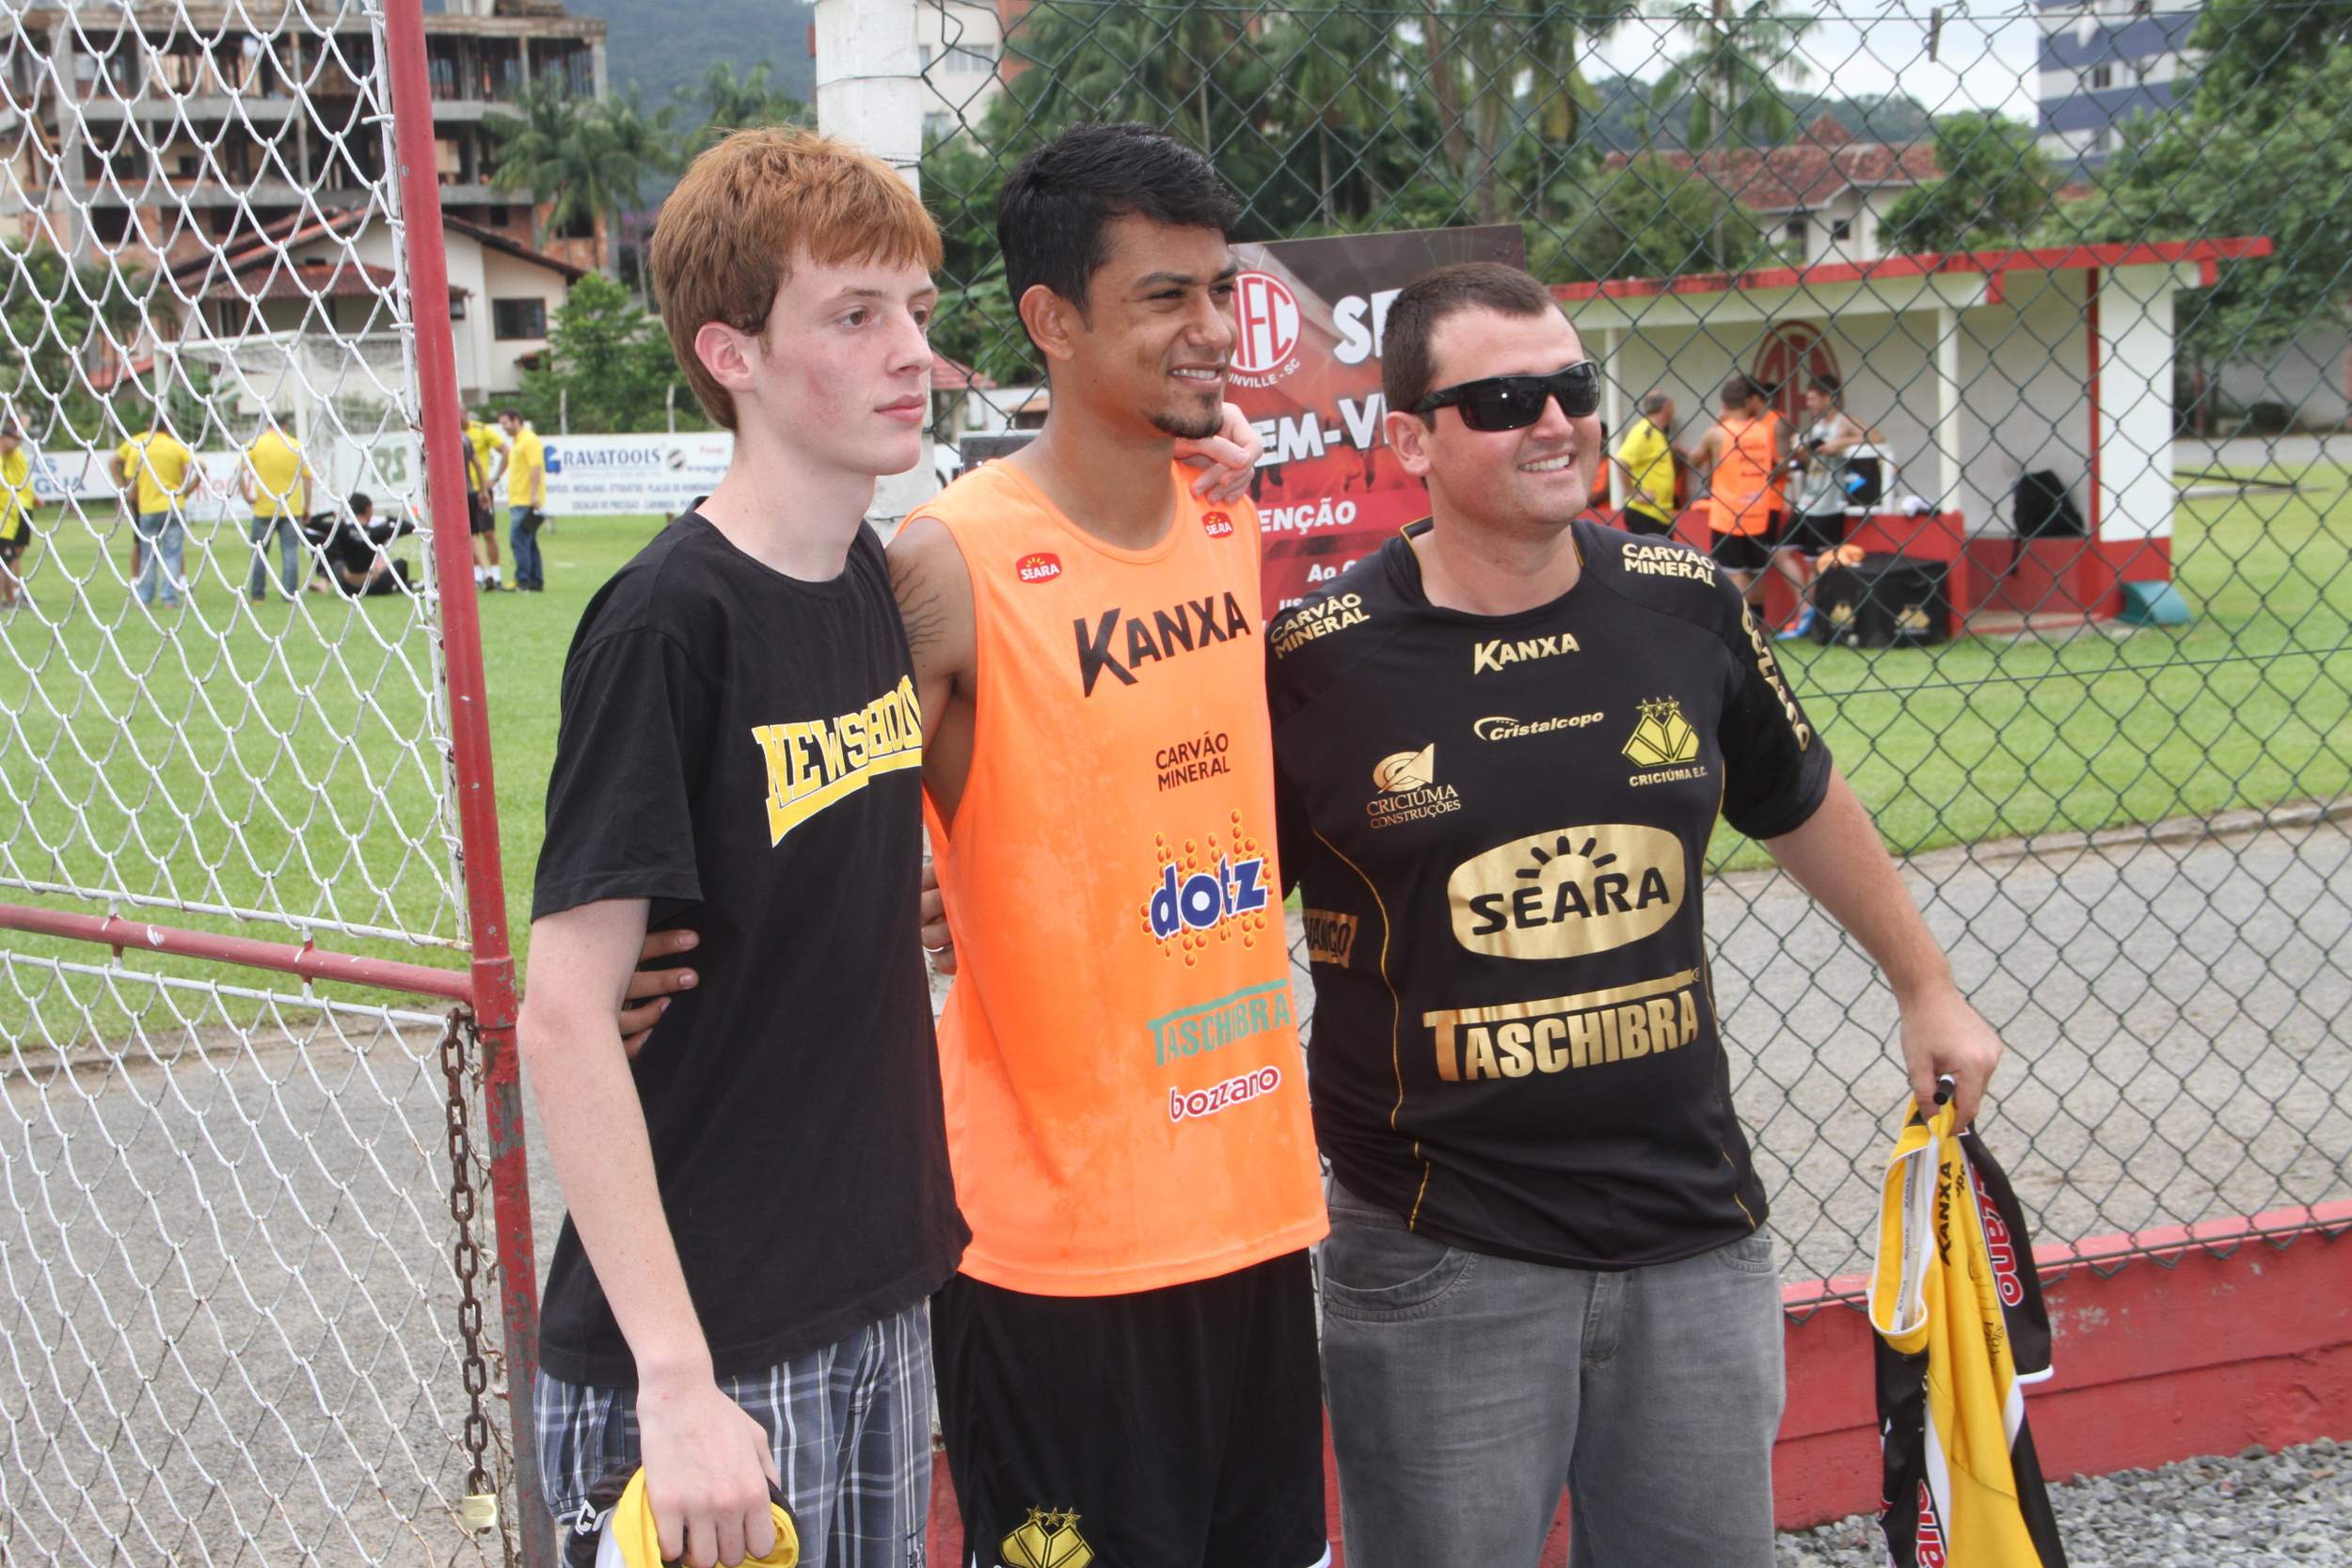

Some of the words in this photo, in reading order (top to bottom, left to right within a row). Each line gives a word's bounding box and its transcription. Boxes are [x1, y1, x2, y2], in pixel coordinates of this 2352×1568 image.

[1229, 372, 1278, 388] INVILLE
[1258, 497, 1357, 535] ENÇÃO
[1020, 563, 1061, 580] SEARA
[1622, 543, 1716, 571] CARVÃO
[1624, 558, 1716, 587] MINERAL
[1270, 593, 1362, 643] CARVÃO
[1275, 607, 1370, 659] MINERAL
[1073, 592, 1251, 698] KANXA
[1473, 632, 1581, 675] KANXA
[1489, 711, 1605, 741] Cristalcopo
[1155, 731, 1229, 770] CARVÃO
[1158, 756, 1231, 792] MINERAL
[1629, 768, 1692, 787] CRICIÚMA
[1366, 784, 1459, 816] CRICIÚMA
[1370, 799, 1461, 829] CONSTRUÇÕES
[1149, 852, 1268, 940] dotz
[1469, 866, 1671, 935] SEARA
[1422, 969, 1699, 1082] TASCHIBRA
[1168, 1065, 1280, 1122] bozzano
[1934, 1161, 1953, 1267] KANXA
